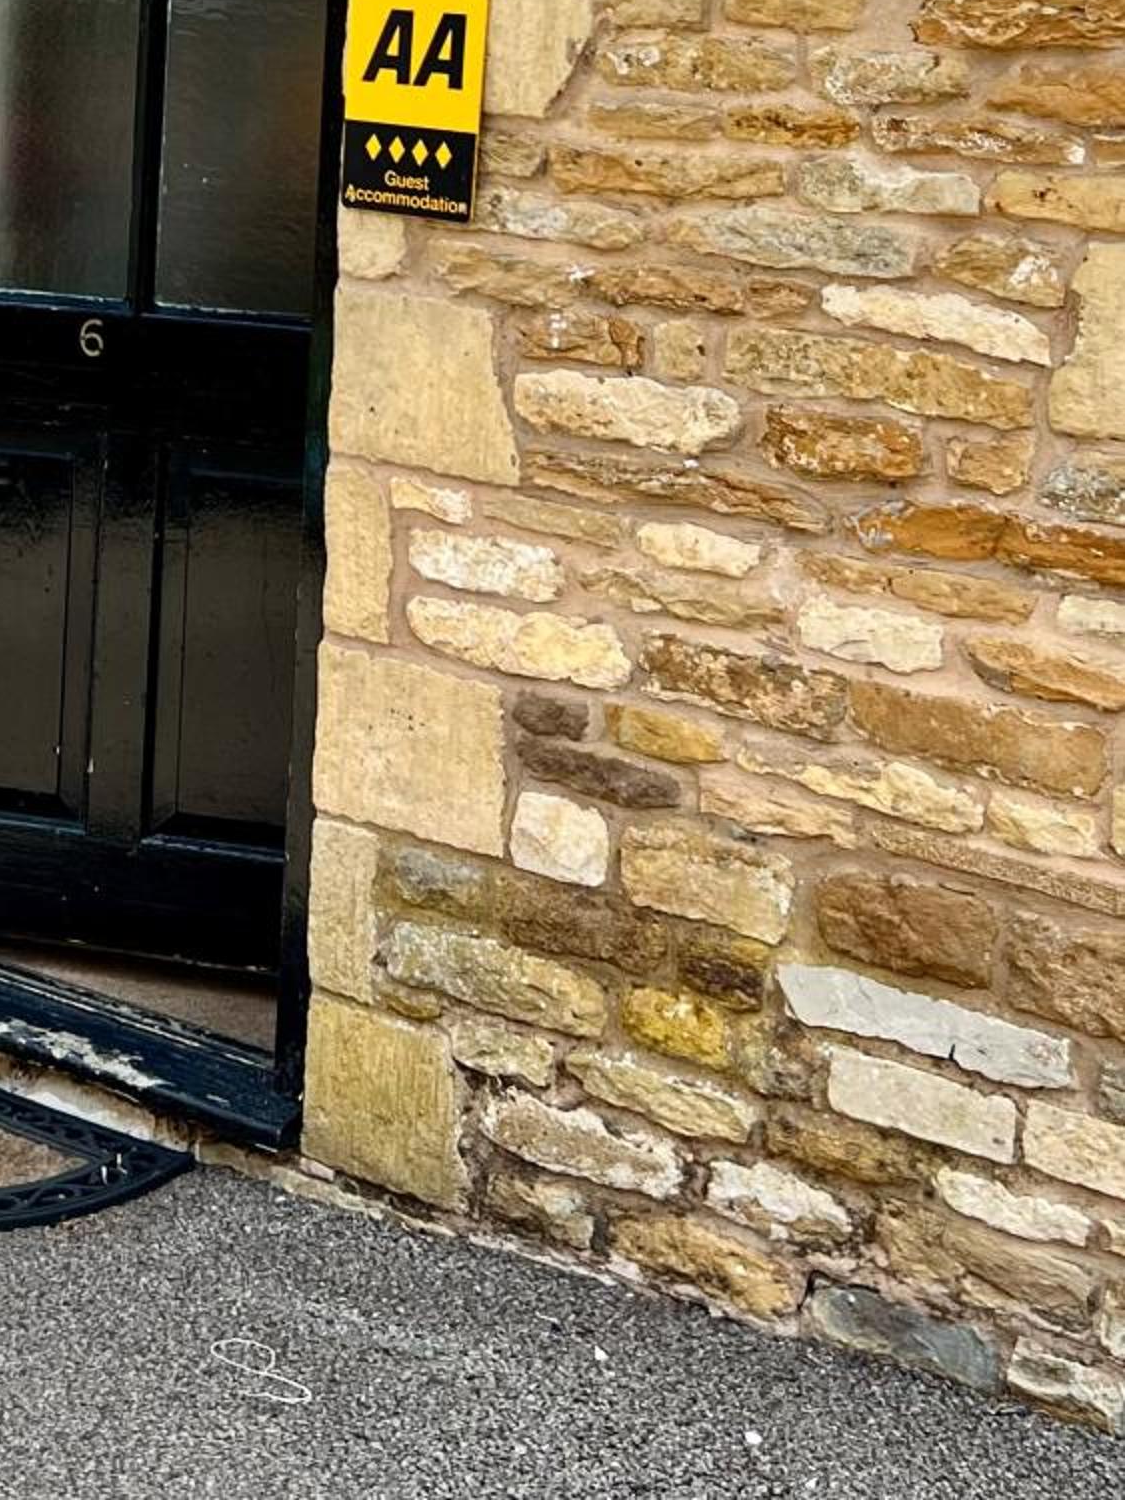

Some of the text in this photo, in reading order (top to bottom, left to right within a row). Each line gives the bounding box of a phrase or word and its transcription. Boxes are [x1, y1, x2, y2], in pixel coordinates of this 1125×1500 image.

[362, 8, 467, 90] AA
[383, 169, 430, 192] Guest
[344, 184, 468, 215] Accommodation
[79, 318, 105, 357] 6
